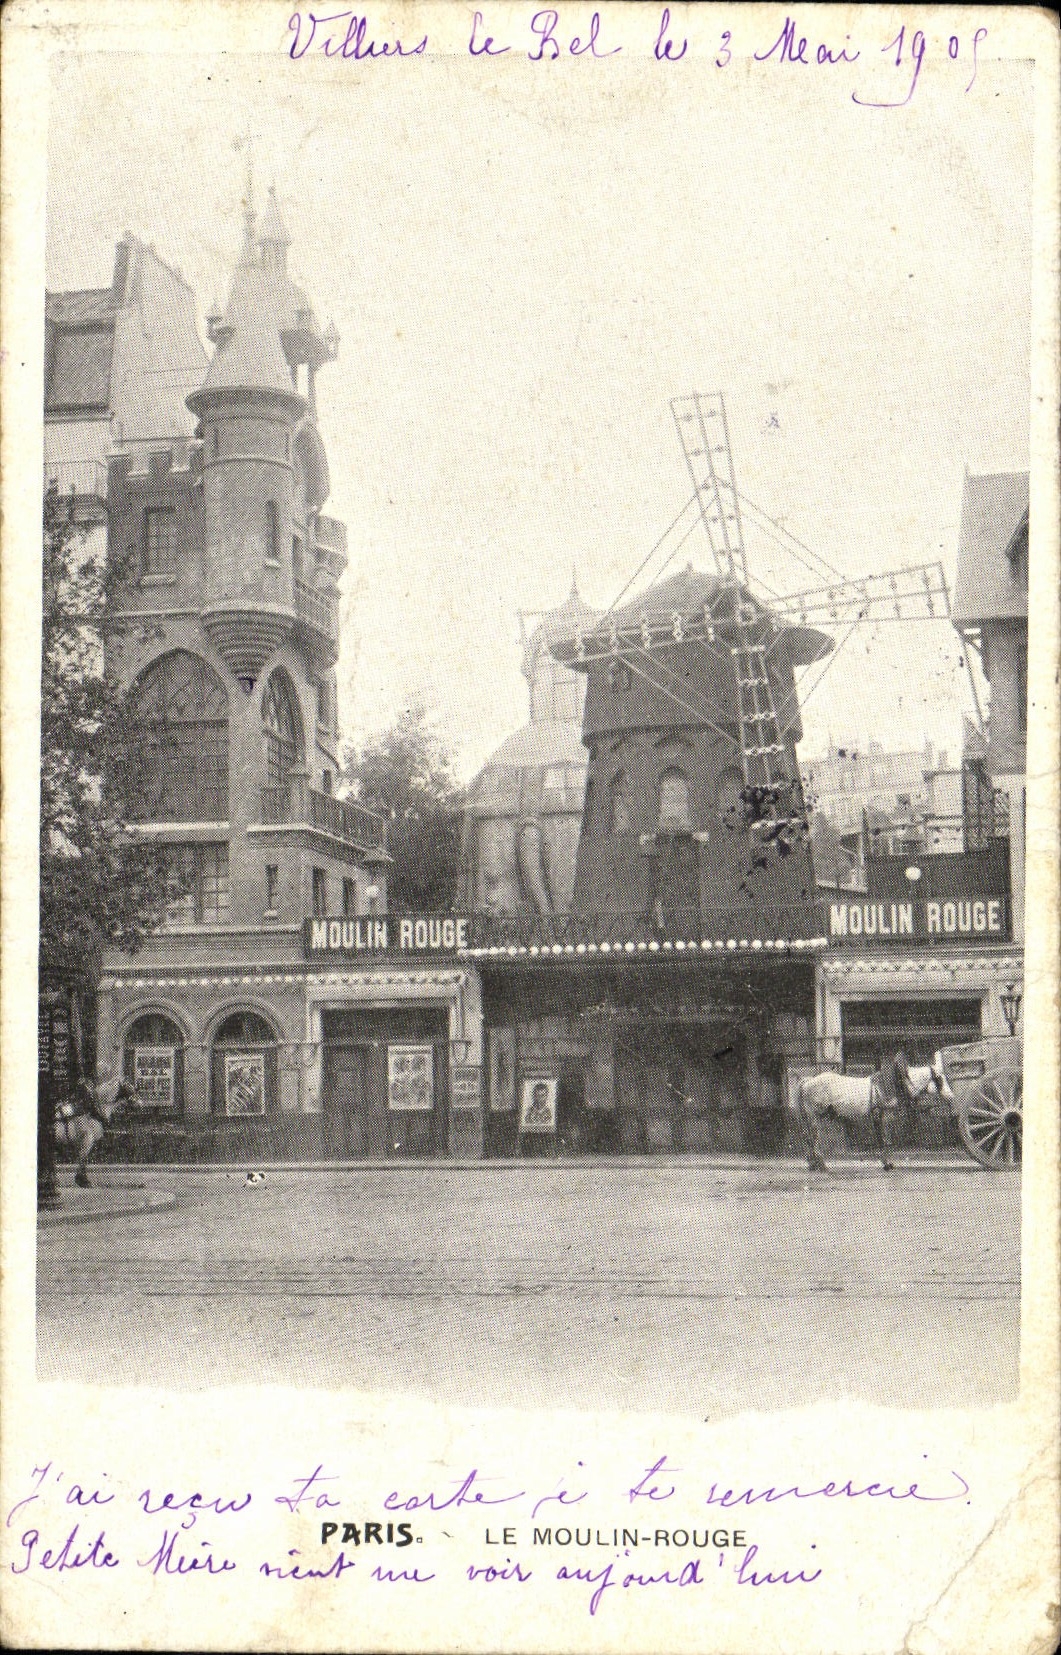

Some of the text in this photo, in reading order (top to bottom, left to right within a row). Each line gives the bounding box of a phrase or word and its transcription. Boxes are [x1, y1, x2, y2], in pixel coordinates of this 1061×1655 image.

[288, 12, 428, 60] Villiers
[469, 11, 511, 56] le
[715, 31, 732, 68] 3
[311, 918, 468, 950] MOULIN ROUGE
[830, 900, 1001, 935] MOULIN ROUGE
[384, 1469, 525, 1511] carte
[466, 1558, 532, 1582] voir
